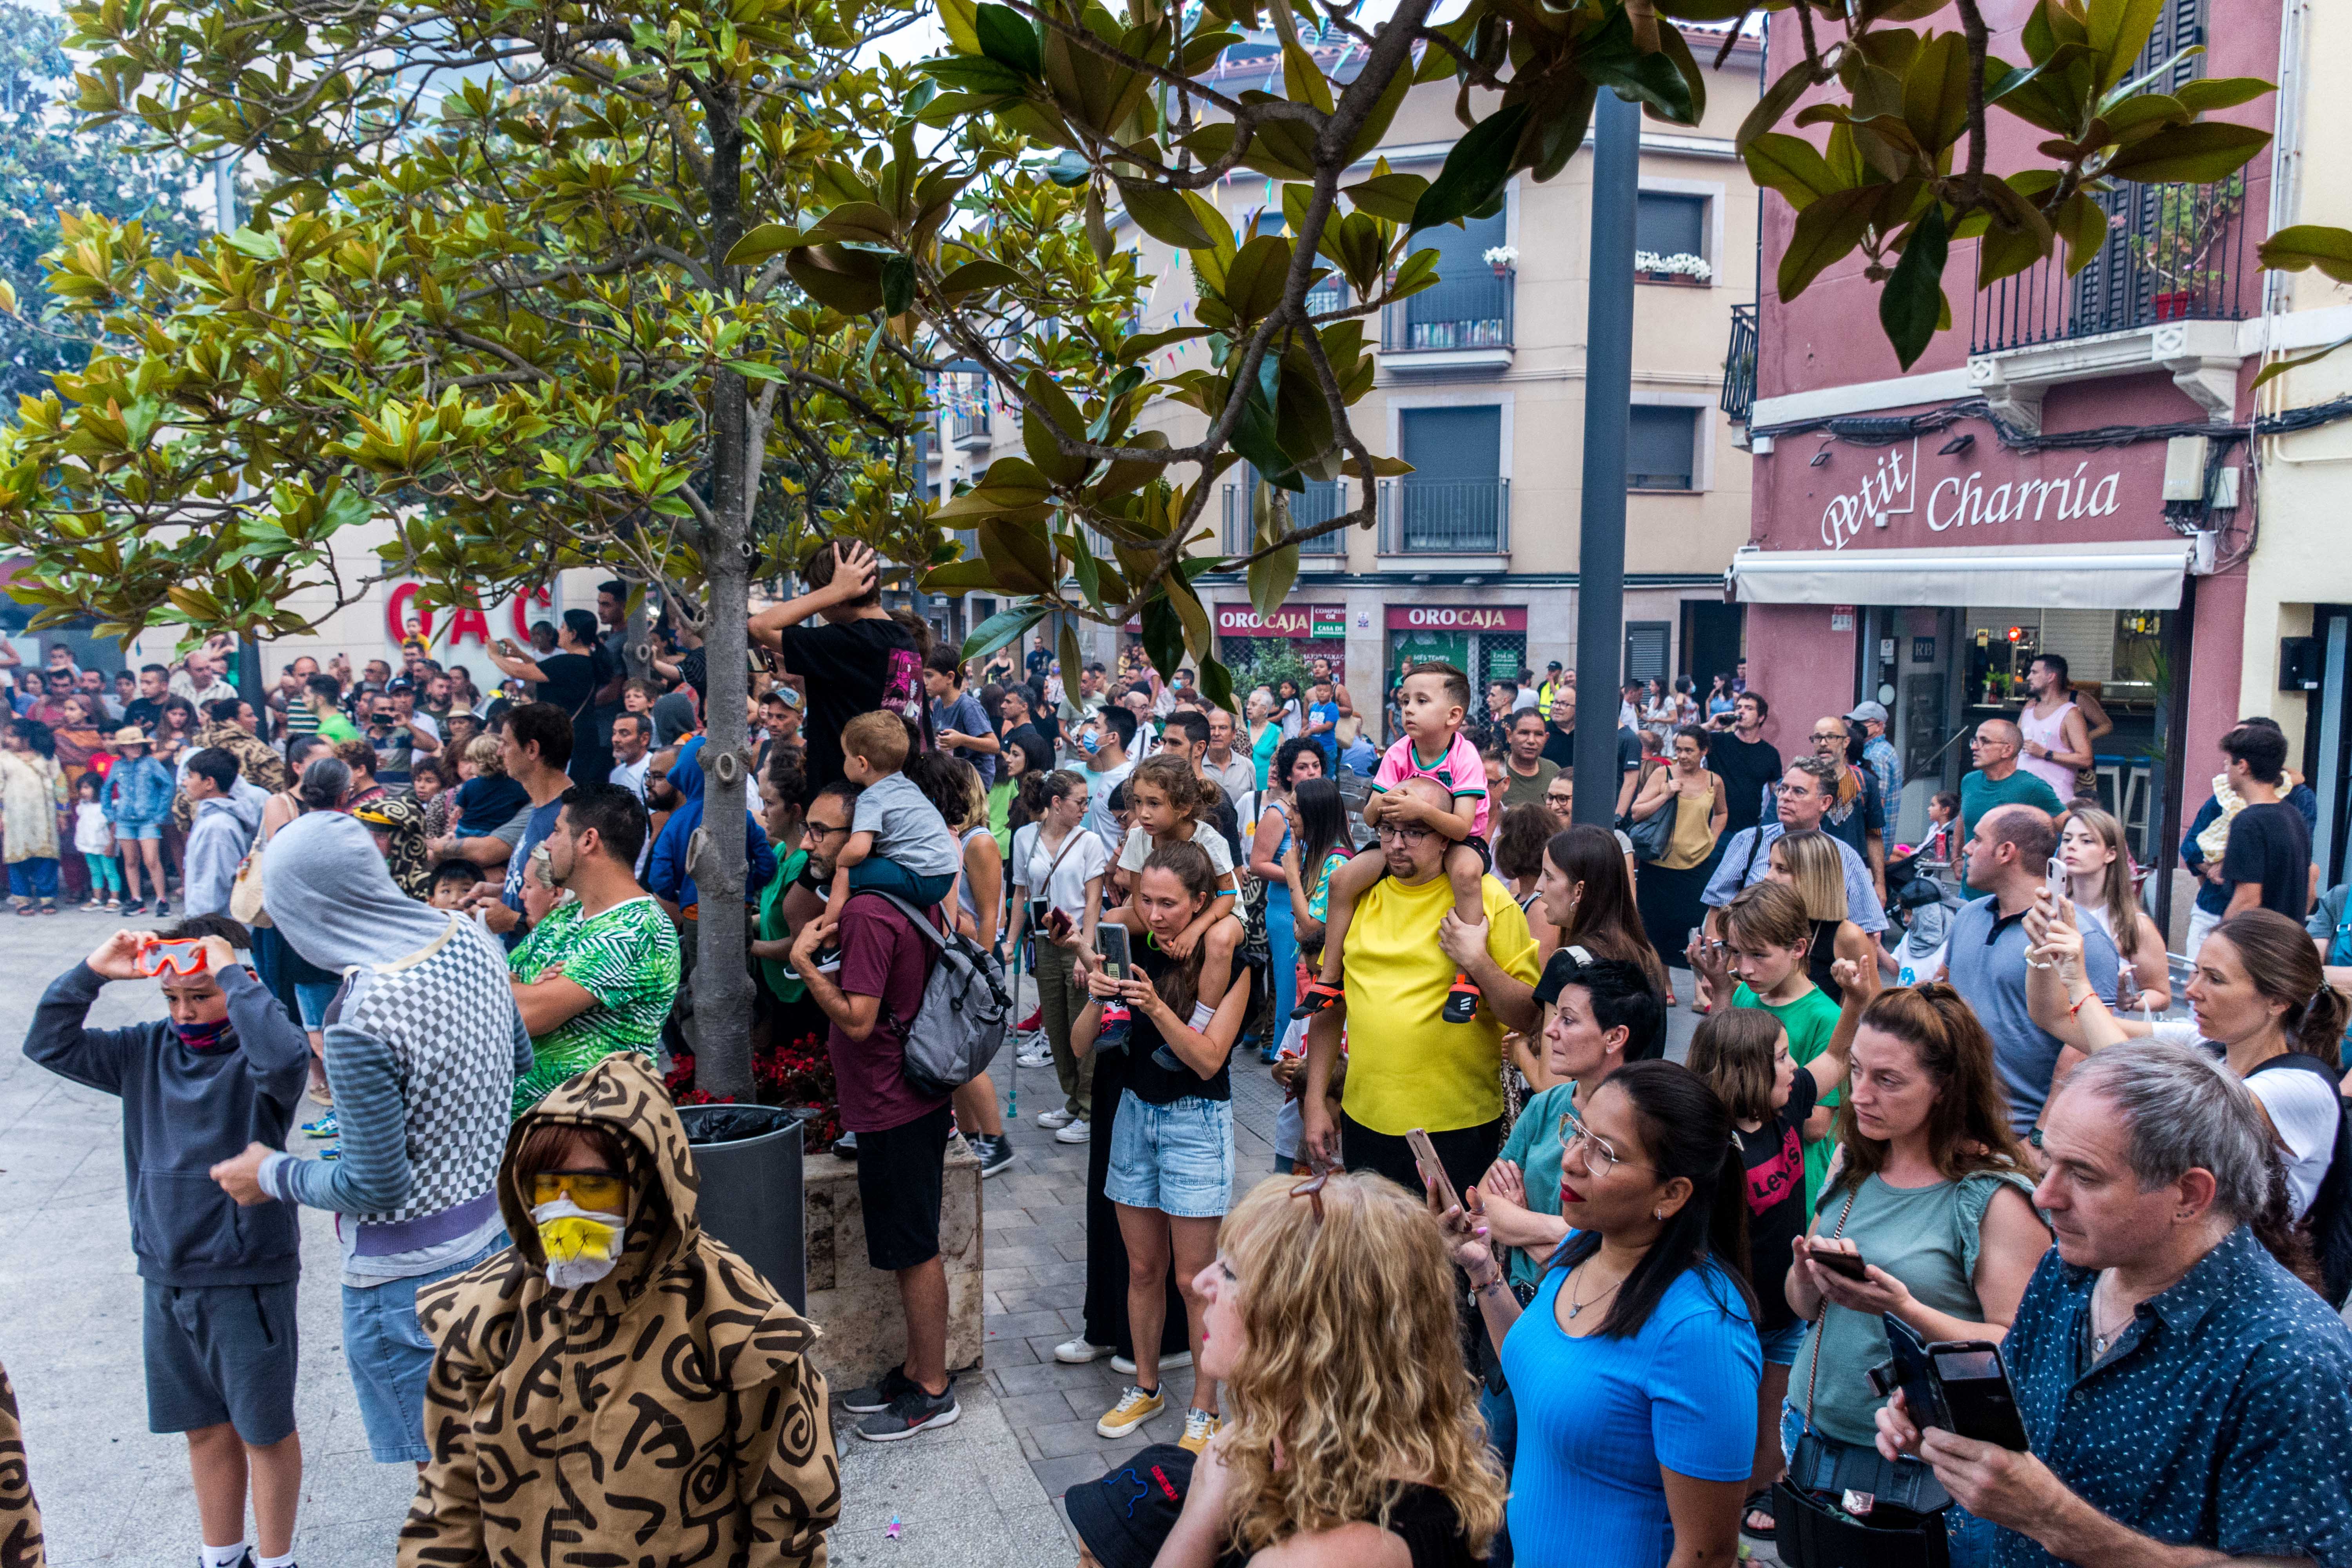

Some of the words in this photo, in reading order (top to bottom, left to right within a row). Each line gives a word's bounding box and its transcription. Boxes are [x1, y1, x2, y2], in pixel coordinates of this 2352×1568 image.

[1821, 448, 1909, 551] Petit
[1927, 462, 2121, 532] Charrúa
[389, 583, 552, 646] OAC
[1220, 612, 1308, 632] OROCAJA
[1409, 609, 1506, 629] OROCAJA
